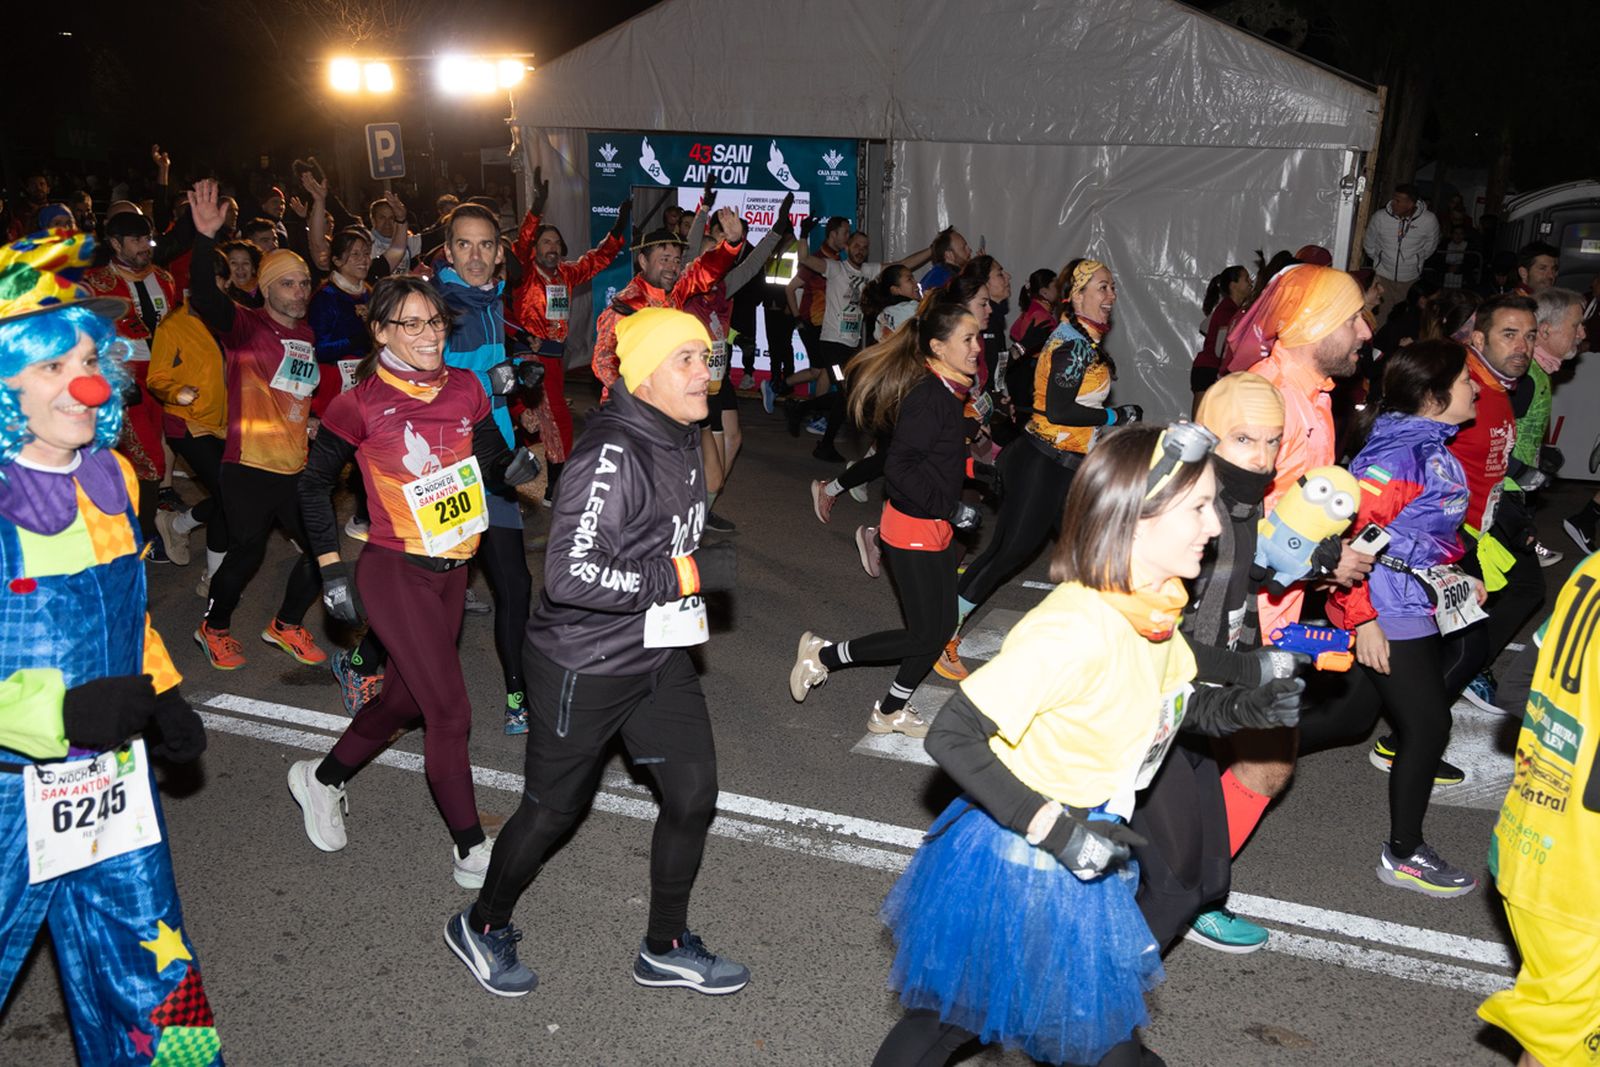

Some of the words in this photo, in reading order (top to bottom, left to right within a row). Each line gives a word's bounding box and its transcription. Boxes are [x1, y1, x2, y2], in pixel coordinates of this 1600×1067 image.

[375, 130, 395, 172] P
[689, 143, 712, 164] 43
[712, 144, 753, 163] SAN
[648, 163, 661, 177] 43
[683, 161, 749, 184] ANTÓN
[776, 167, 789, 182] 43
[744, 211, 774, 225] SAN
[290, 359, 314, 378] 8217
[595, 443, 624, 475] LA
[425, 478, 445, 497] NOCHE
[445, 475, 454, 485] DE
[419, 494, 434, 507] SAN
[435, 491, 471, 524] 230
[601, 567, 641, 593] UNE
[1443, 581, 1470, 610] 5600
[1547, 573, 1600, 694] 10
[41, 787, 69, 801] SAN
[52, 781, 126, 833] 6245
[1398, 864, 1422, 878] HOKA
